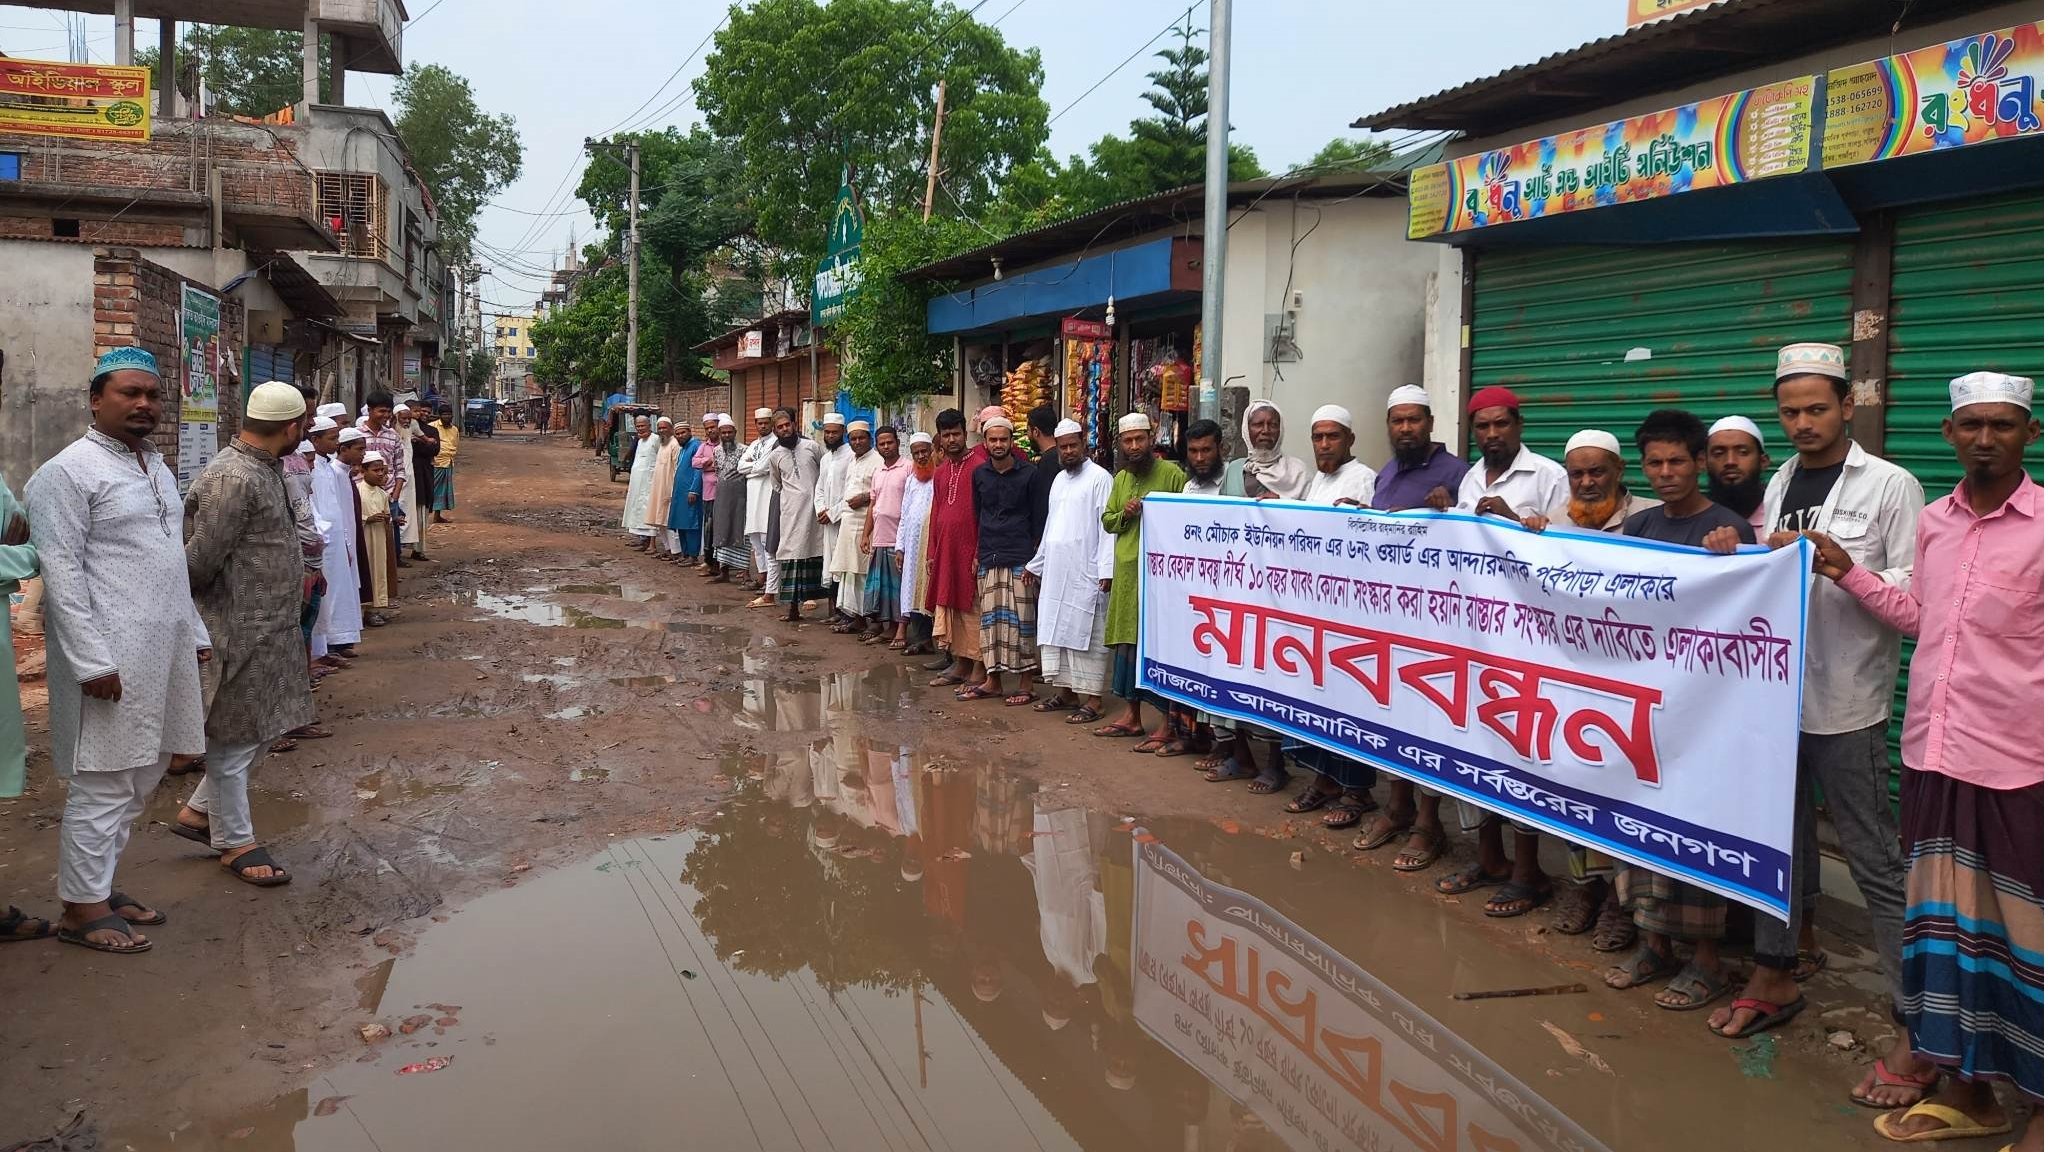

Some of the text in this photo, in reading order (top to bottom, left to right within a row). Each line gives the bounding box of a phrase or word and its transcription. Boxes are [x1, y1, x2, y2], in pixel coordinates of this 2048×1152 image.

[7, 70, 143, 95] আইডিয়াল স্কুল
[1921, 75, 2040, 137] রংধনু
[1523, 163, 1552, 200] আর্ট
[1584, 142, 1631, 189] আইটি
[1184, 522, 1678, 601] ৪নং মৌচাক ইউনিয়ন পরিষদ এর ৬নং ওয়ার্ড এর আন্দারমানিক পূর্বপাড়া এলাকার
[1168, 553, 1195, 582] বেহাল
[1224, 550, 1247, 588] দীর্ঘ
[1249, 567, 1263, 591] ১০
[1266, 566, 1288, 597] বছর
[1290, 567, 1312, 596] যাবৎ
[1316, 573, 1350, 609] কোনো
[1353, 576, 1392, 616] সংস্কার
[1396, 584, 1424, 622] করা
[1427, 580, 1462, 630] হয়নি
[1465, 594, 1509, 636] রাস্তার
[1513, 602, 1560, 649] সংস্কার
[1562, 614, 1587, 652] এর
[1587, 607, 1656, 662] দাবিতে
[1664, 616, 1792, 684] এলাকাবাসীর
[1188, 595, 1664, 788] মানববন্ধন
[1227, 689, 1389, 750] আন্দারমানিক
[1397, 744, 1446, 772] এর
[1452, 759, 1600, 825] সর্বস্তরের
[1611, 811, 1760, 877] জনগণ
